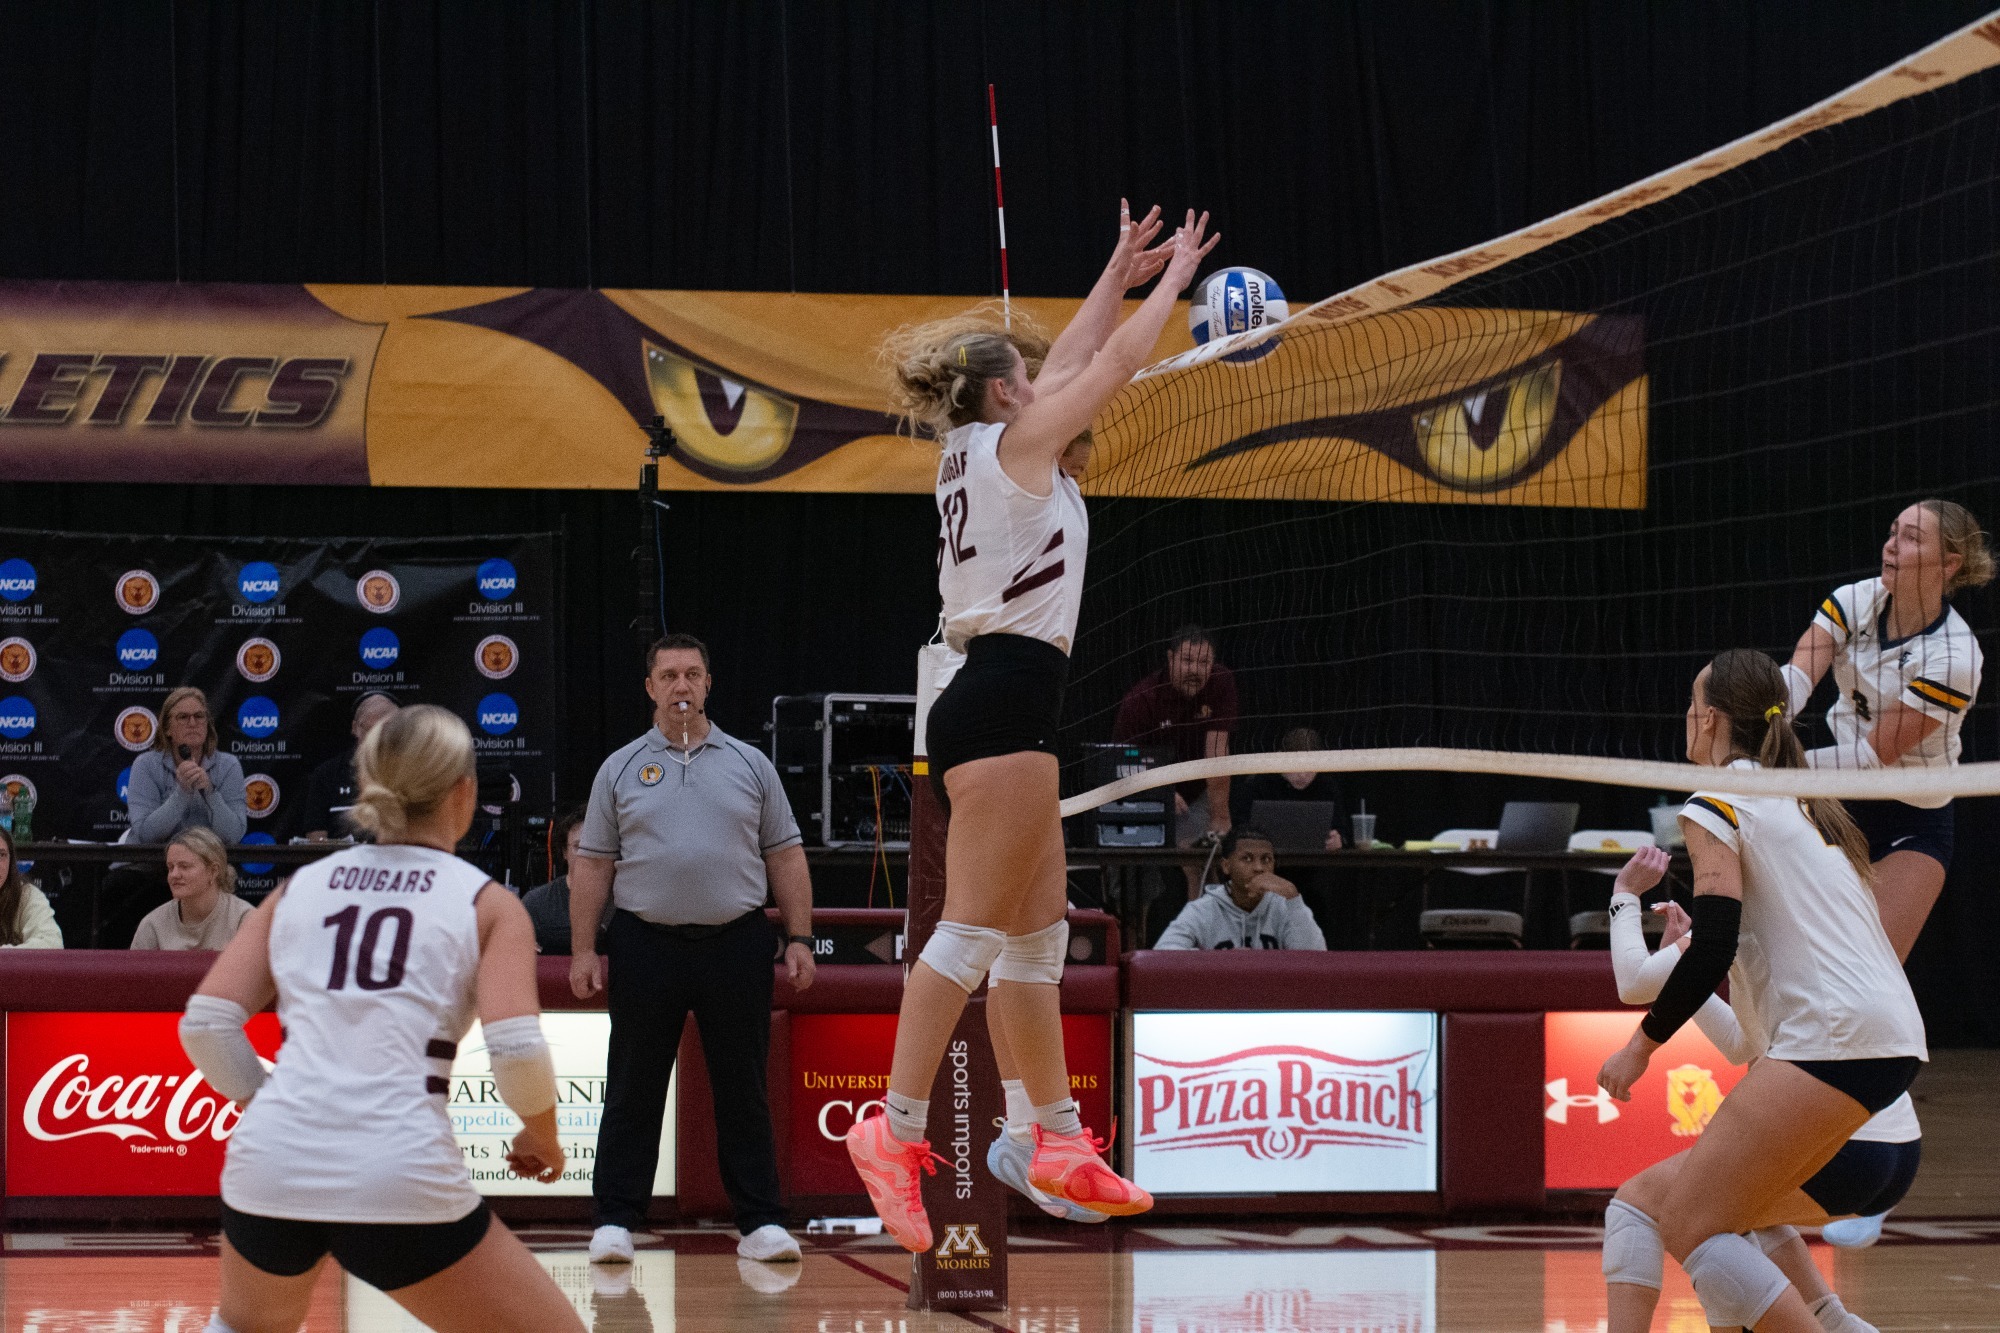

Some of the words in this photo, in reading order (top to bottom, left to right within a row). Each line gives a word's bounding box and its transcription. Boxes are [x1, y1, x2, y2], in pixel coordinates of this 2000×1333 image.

[1248, 281, 1265, 330] molte
[0, 353, 352, 428] ETICS
[943, 487, 977, 566] 12
[0, 579, 35, 591] NCAA
[242, 581, 278, 592] NCAA
[480, 578, 516, 589] NCAA
[0, 604, 31, 615] vision
[232, 605, 275, 616] Division
[278, 604, 286, 615] III
[469, 603, 512, 614] Division
[515, 602, 524, 613] III
[120, 649, 157, 661] NCAA
[363, 647, 398, 659] NCAA
[110, 673, 153, 685] Division
[156, 673, 164, 684] III
[352, 672, 393, 683] Division
[0, 717, 35, 728] NCAA
[242, 716, 278, 728] NCAA
[481, 713, 517, 725] NCAA
[0, 742, 31, 753] vision
[231, 741, 275, 752] Division
[277, 741, 286, 752] III
[516, 737, 525, 748] III
[238, 878, 273, 888] ivision
[328, 866, 438, 893] COUGARS
[323, 904, 414, 991] 10
[803, 1072, 891, 1089] UNIVERSIT
[1071, 1075, 1098, 1089] RIS
[949, 1040, 972, 1110] sports
[23, 1053, 246, 1141] Coca-Co
[1138, 1073, 1269, 1136] Pizza
[1277, 1060, 1424, 1133] Ranch
[451, 1111, 515, 1132] opedic
[130, 1144, 174, 1154] Trade-mark
[950, 1114, 974, 1199] imports
[936, 1258, 990, 1269] MORRIS
[937, 1290, 957, 1299] (800)
[959, 1289, 994, 1299] 556-3198
